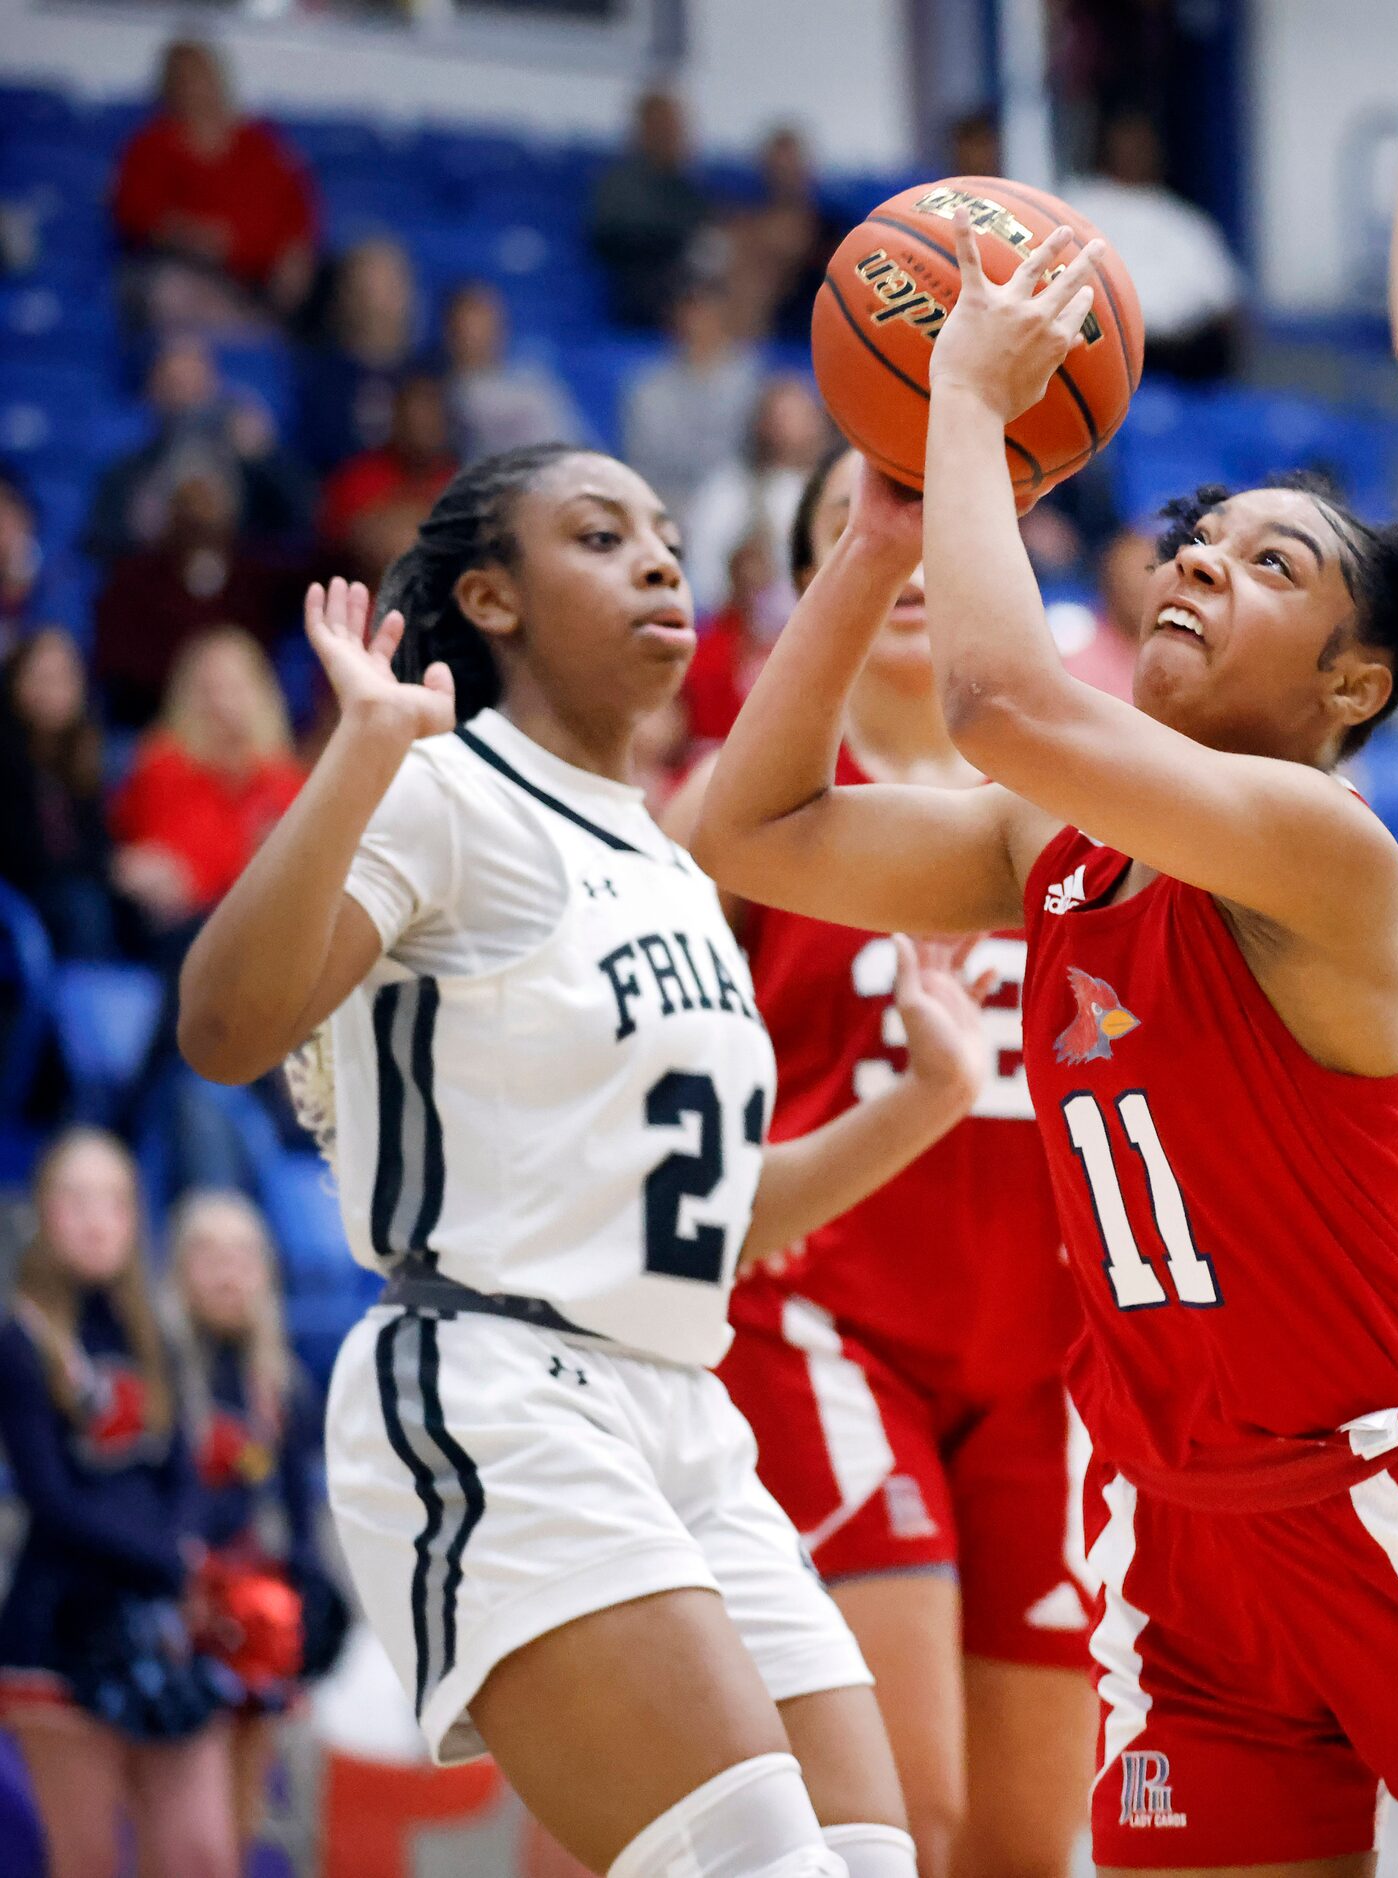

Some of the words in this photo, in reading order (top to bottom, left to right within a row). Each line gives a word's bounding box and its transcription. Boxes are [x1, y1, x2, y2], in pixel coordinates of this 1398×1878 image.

[599, 931, 766, 1043] FRIA
[643, 1067, 764, 1286] 2
[1059, 1087, 1225, 1312] 11
